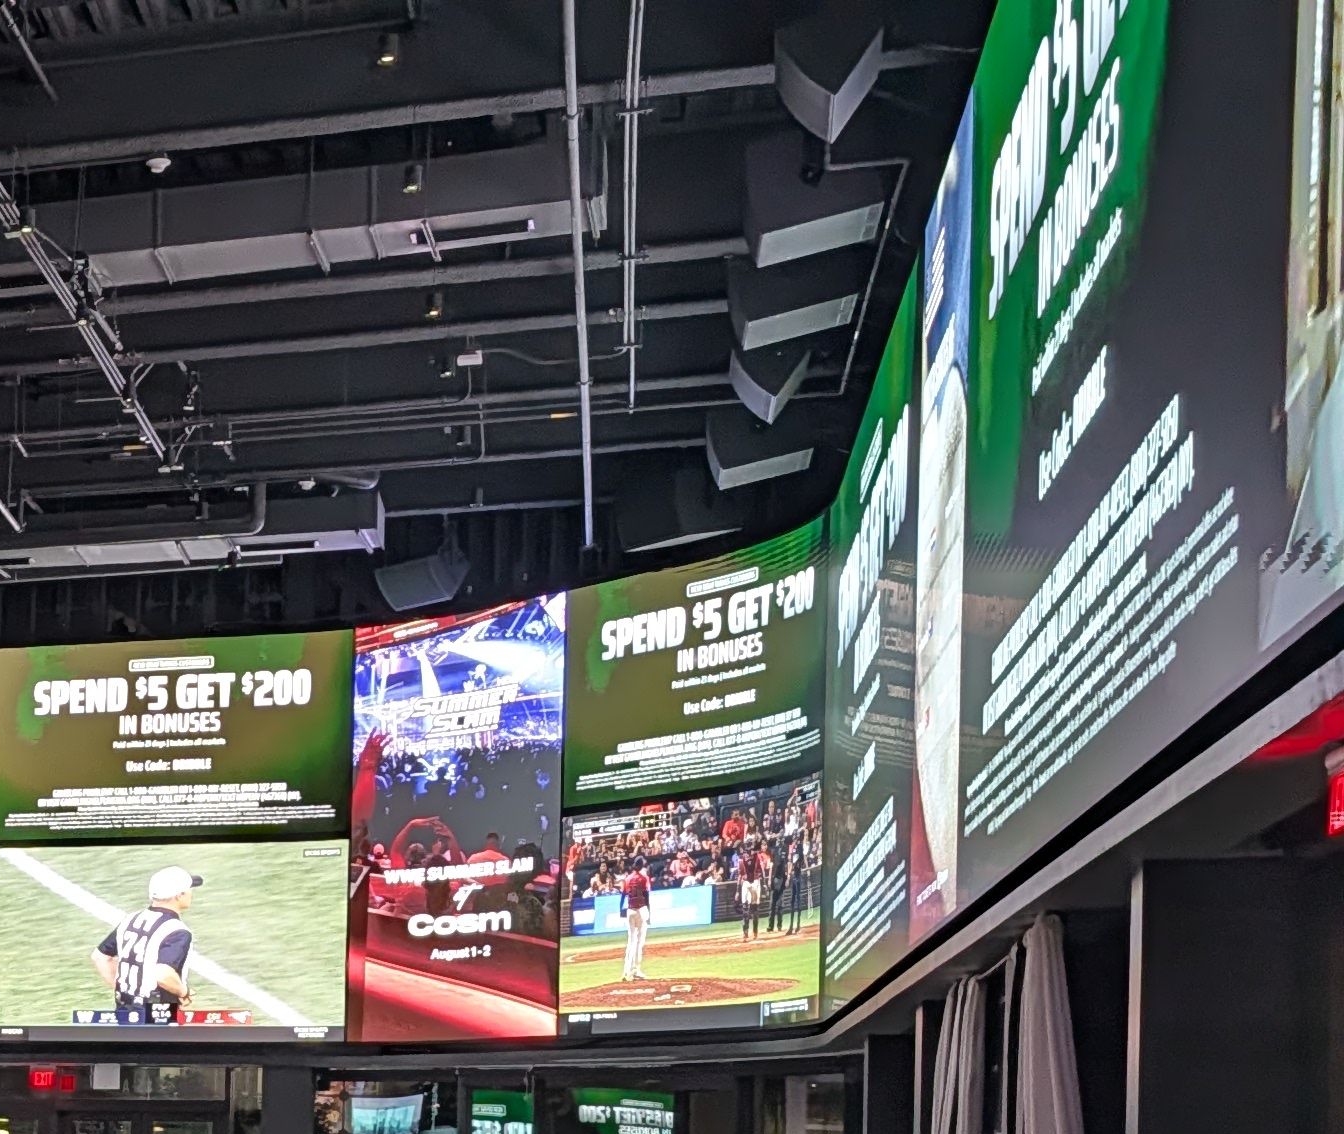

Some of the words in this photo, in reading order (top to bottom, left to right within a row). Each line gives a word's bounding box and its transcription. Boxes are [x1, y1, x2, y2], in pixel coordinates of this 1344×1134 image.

[989, 36, 1049, 320] SPEND
[1037, 206, 1052, 319] IN
[1053, 56, 1120, 286] BONUSES
[601, 606, 686, 661] SPEND
[692, 598, 722, 640] $5
[728, 583, 773, 634] GET
[776, 566, 815, 619] $200
[677, 648, 695, 673] IN
[697, 632, 763, 669] BONUSES
[33, 677, 128, 716] SPEND
[135, 676, 169, 711] $5
[175, 672, 236, 709] GET
[241, 669, 312, 706] $200
[411, 683, 520, 716] SUMMER
[684, 702, 699, 715] Use
[701, 697, 723, 712] Code:
[119, 715, 138, 735] IN
[141, 711, 221, 734] BONUSES
[432, 706, 501, 733] SLAM
[126, 760, 142, 773] Use
[144, 759, 170, 772] Code:
[384, 868, 425, 884] WWE
[427, 863, 494, 881] SUMMER
[496, 857, 533, 874] SLAM
[430, 946, 469, 961] August
[184, 1012, 194, 1023] 7
[34, 1071, 54, 1086] EXIT
